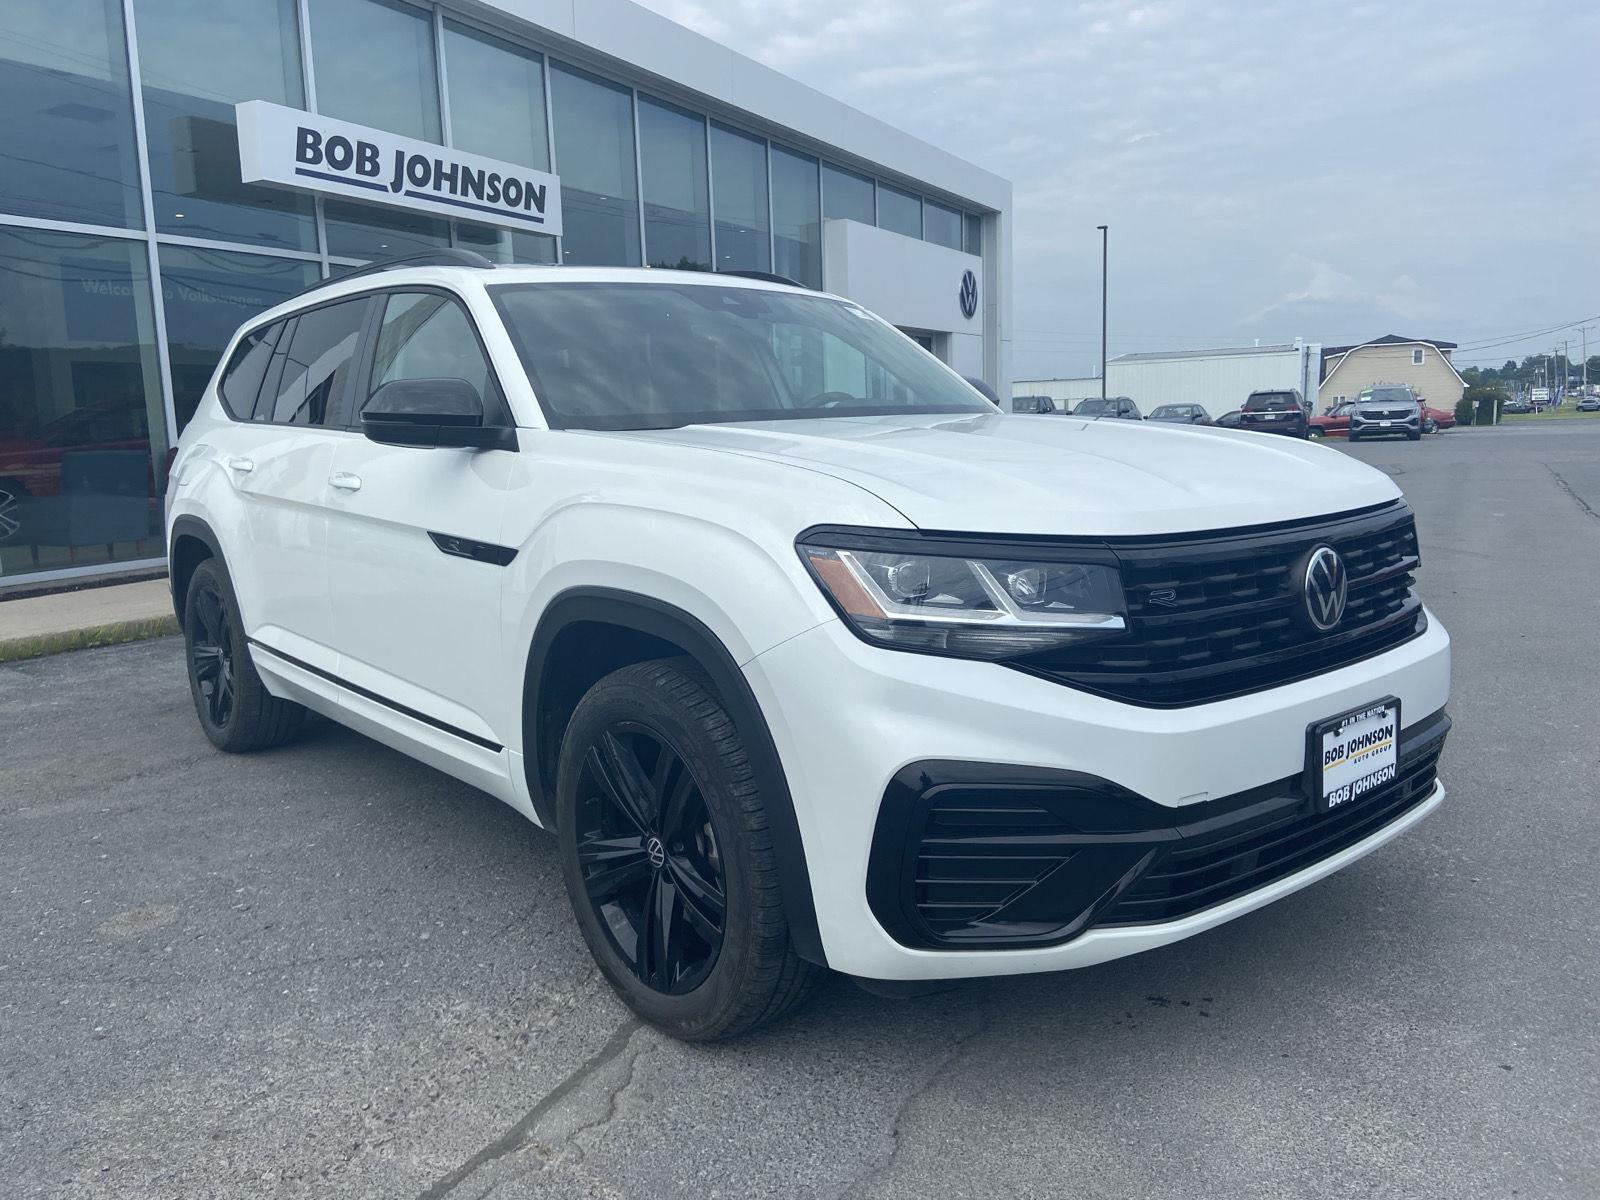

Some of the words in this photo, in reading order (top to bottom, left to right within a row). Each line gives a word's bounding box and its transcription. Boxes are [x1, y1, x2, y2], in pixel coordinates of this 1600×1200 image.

[295, 126, 381, 177] BOB
[390, 149, 547, 214] JOHNSON
[82, 278, 134, 297] Welco
[1324, 744, 1345, 766] BOB
[1346, 724, 1394, 760] JOHNSON
[1353, 754, 1369, 764] AUTO
[1371, 743, 1392, 757] GROUP
[1328, 784, 1350, 808] BOB
[1351, 763, 1396, 802] JOHNSON
